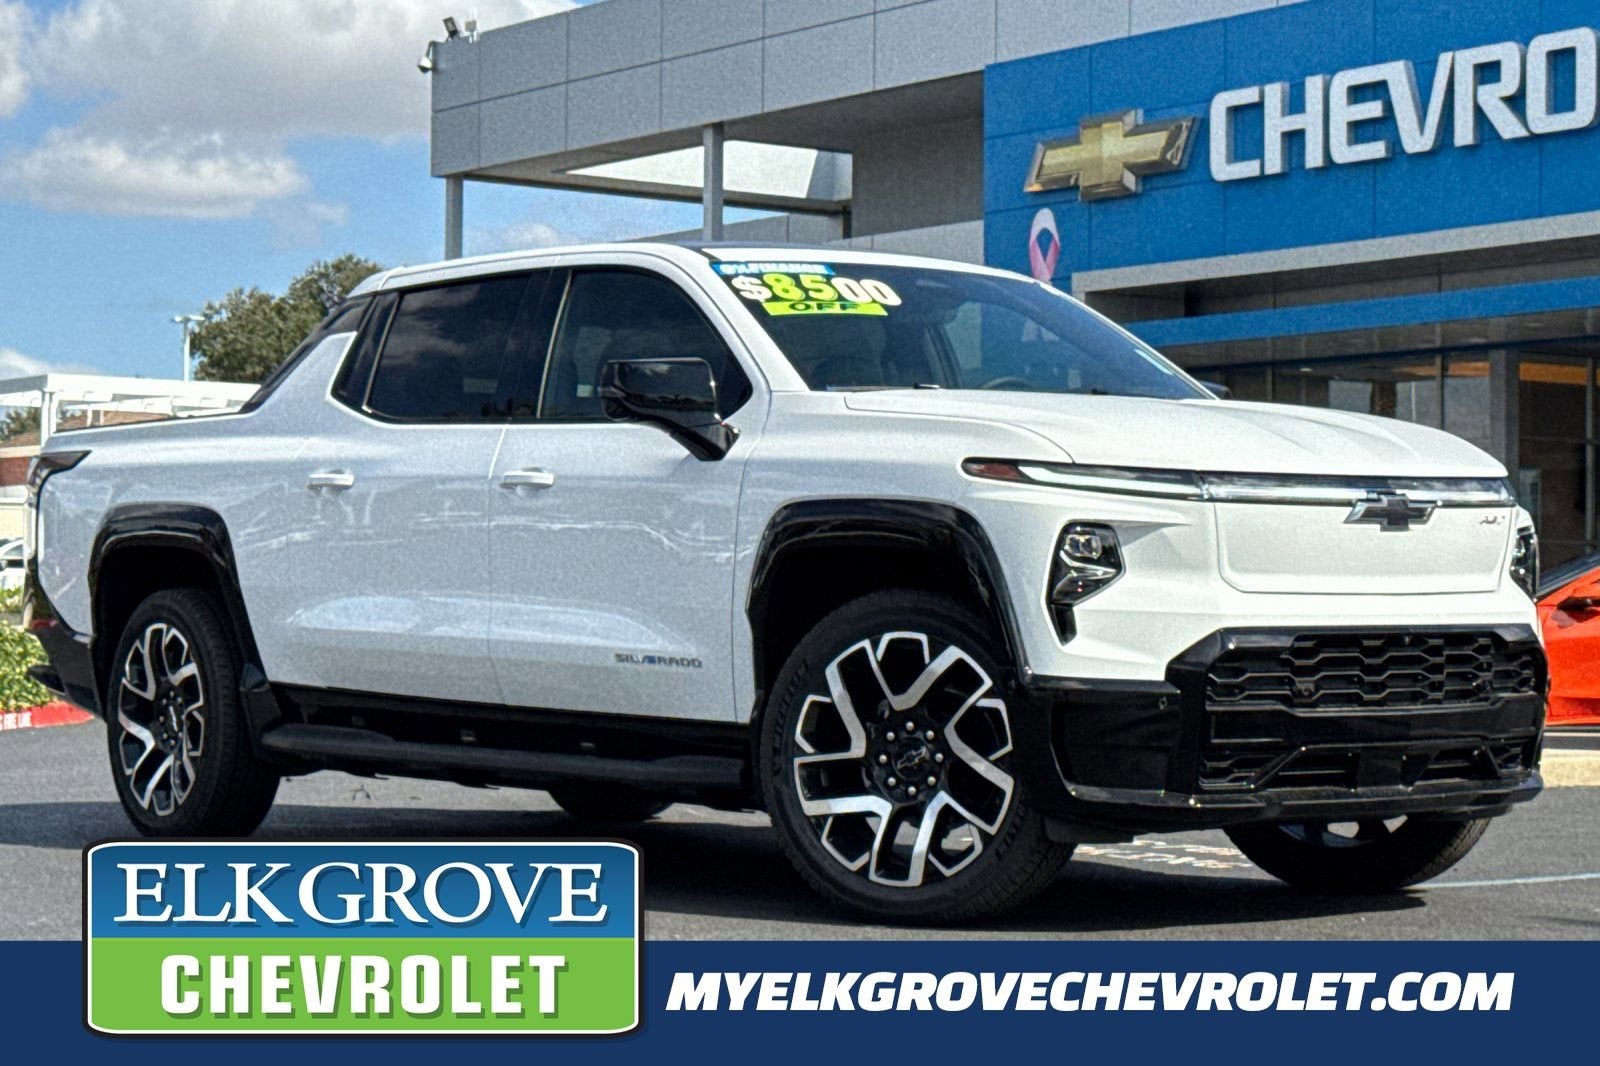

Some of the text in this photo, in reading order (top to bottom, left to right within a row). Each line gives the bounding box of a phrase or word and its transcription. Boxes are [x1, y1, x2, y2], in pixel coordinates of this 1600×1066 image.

[1209, 26, 1600, 182] CHEVRO
[731, 273, 902, 306] $8500
[788, 301, 861, 312] OFF
